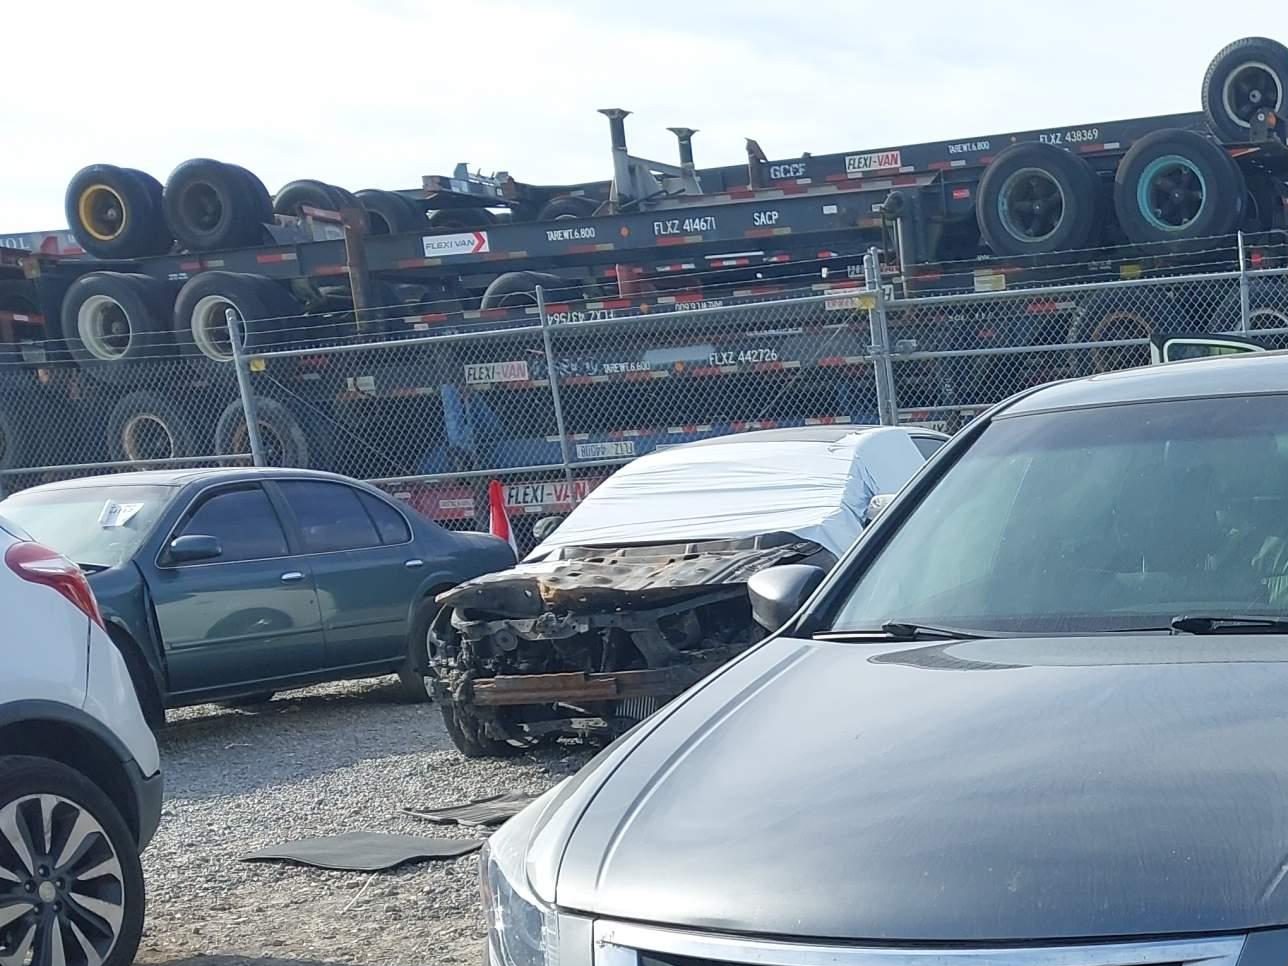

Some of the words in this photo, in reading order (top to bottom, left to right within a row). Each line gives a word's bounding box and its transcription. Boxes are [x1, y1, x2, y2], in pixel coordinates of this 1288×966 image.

[1039, 132, 1062, 144] FLXZ
[1065, 128, 1099, 143] 438369
[848, 153, 898, 171] FLEXI-VAN
[654, 220, 680, 236] FLXZ
[683, 216, 717, 232] 414671
[753, 211, 779, 226] SACP
[709, 352, 736, 366] FLXZ
[738, 349, 778, 363] 442726
[467, 361, 527, 381] FLEXI-VAN
